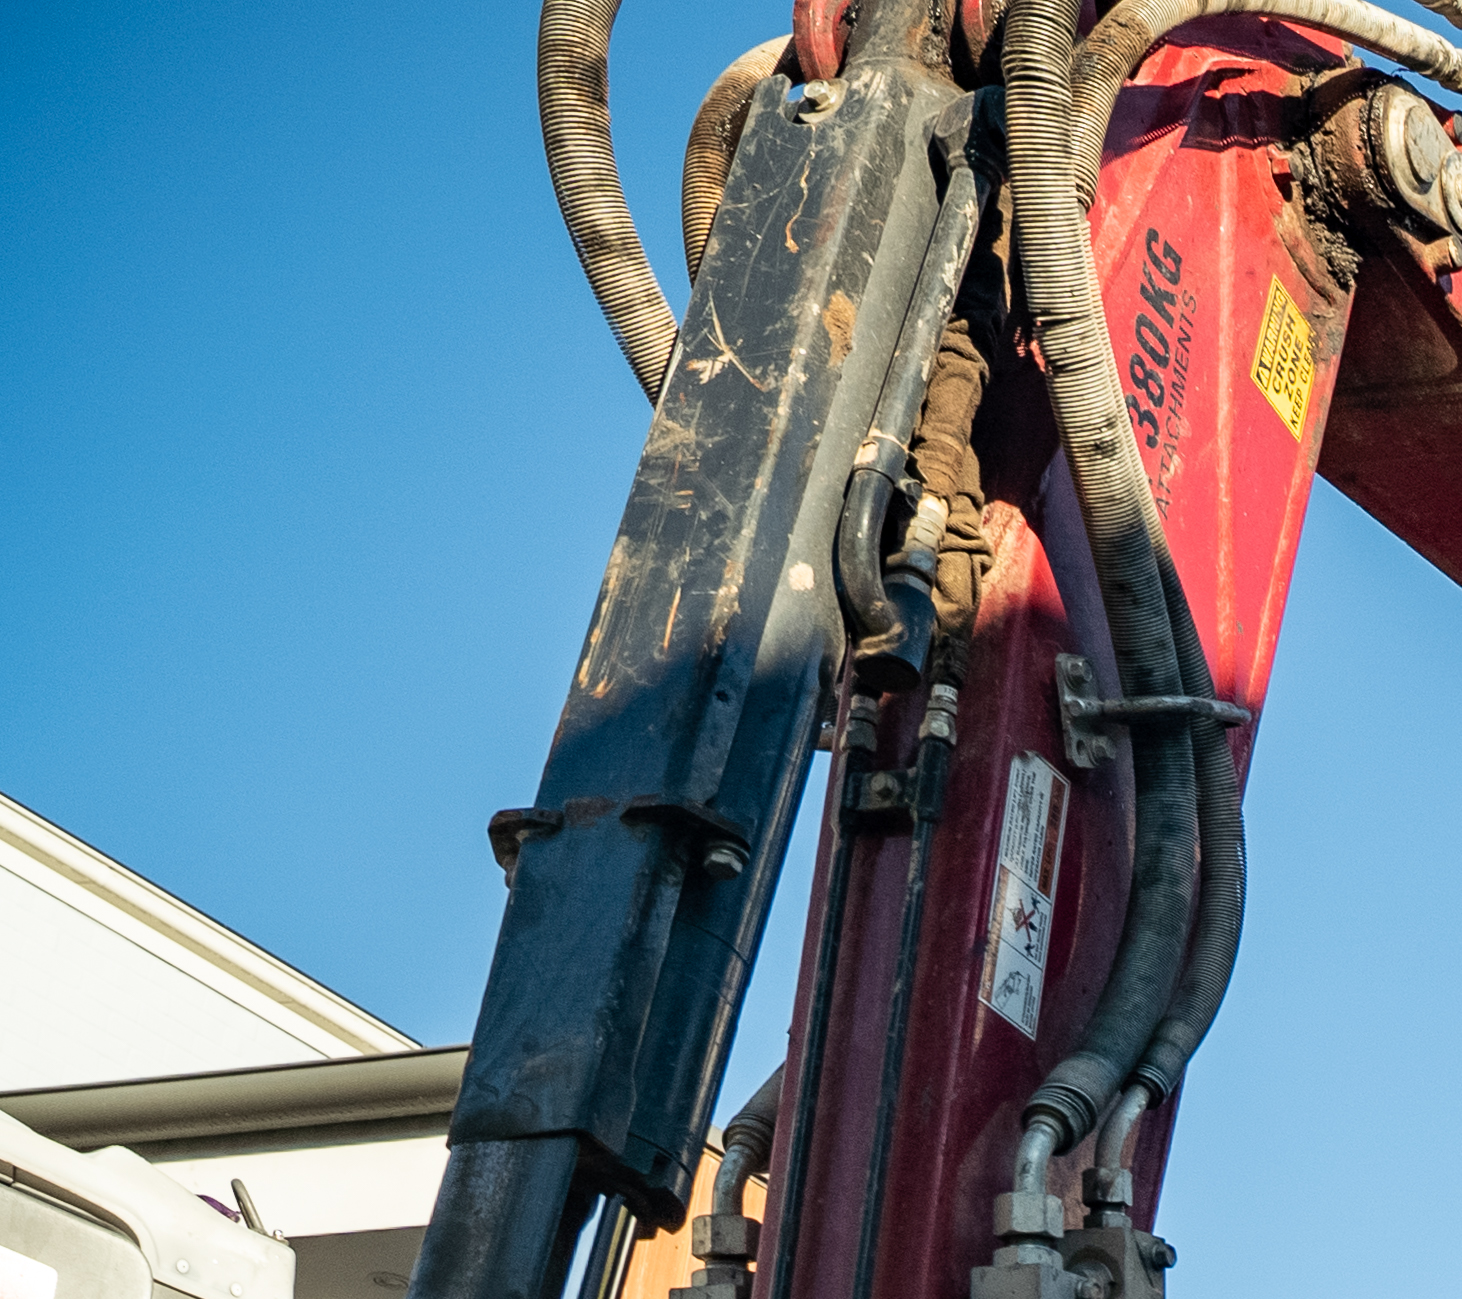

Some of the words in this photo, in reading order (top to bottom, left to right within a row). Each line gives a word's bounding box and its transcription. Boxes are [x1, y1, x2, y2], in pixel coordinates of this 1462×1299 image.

[1125, 227, 1182, 450] 380KG
[1260, 290, 1287, 371] WARNING
[1272, 313, 1296, 395] CRUSH
[1284, 338, 1304, 401] ZONE
[1155, 289, 1197, 520] ATTACHMENTS
[1289, 388, 1305, 430] KEEP
